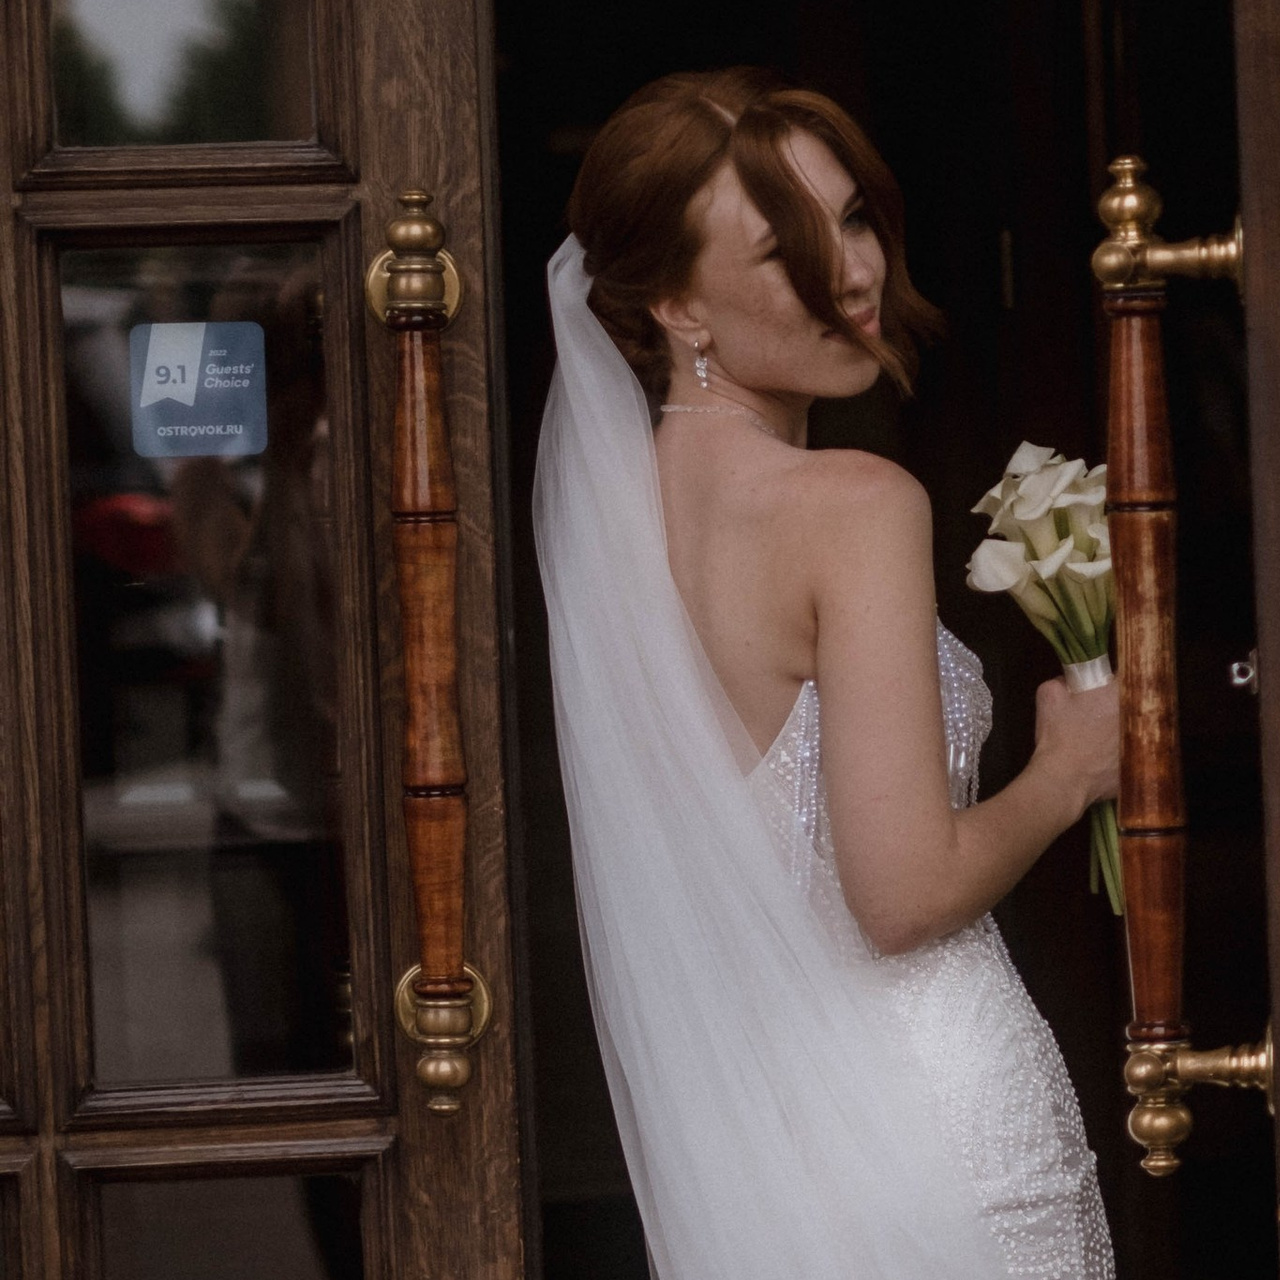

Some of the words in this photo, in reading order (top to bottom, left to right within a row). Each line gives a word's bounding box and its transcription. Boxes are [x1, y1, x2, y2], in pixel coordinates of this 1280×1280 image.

[155, 365, 187, 385] 9.1
[204, 376, 250, 389] Choice
[157, 424, 243, 437] OSTROVOK.RU
